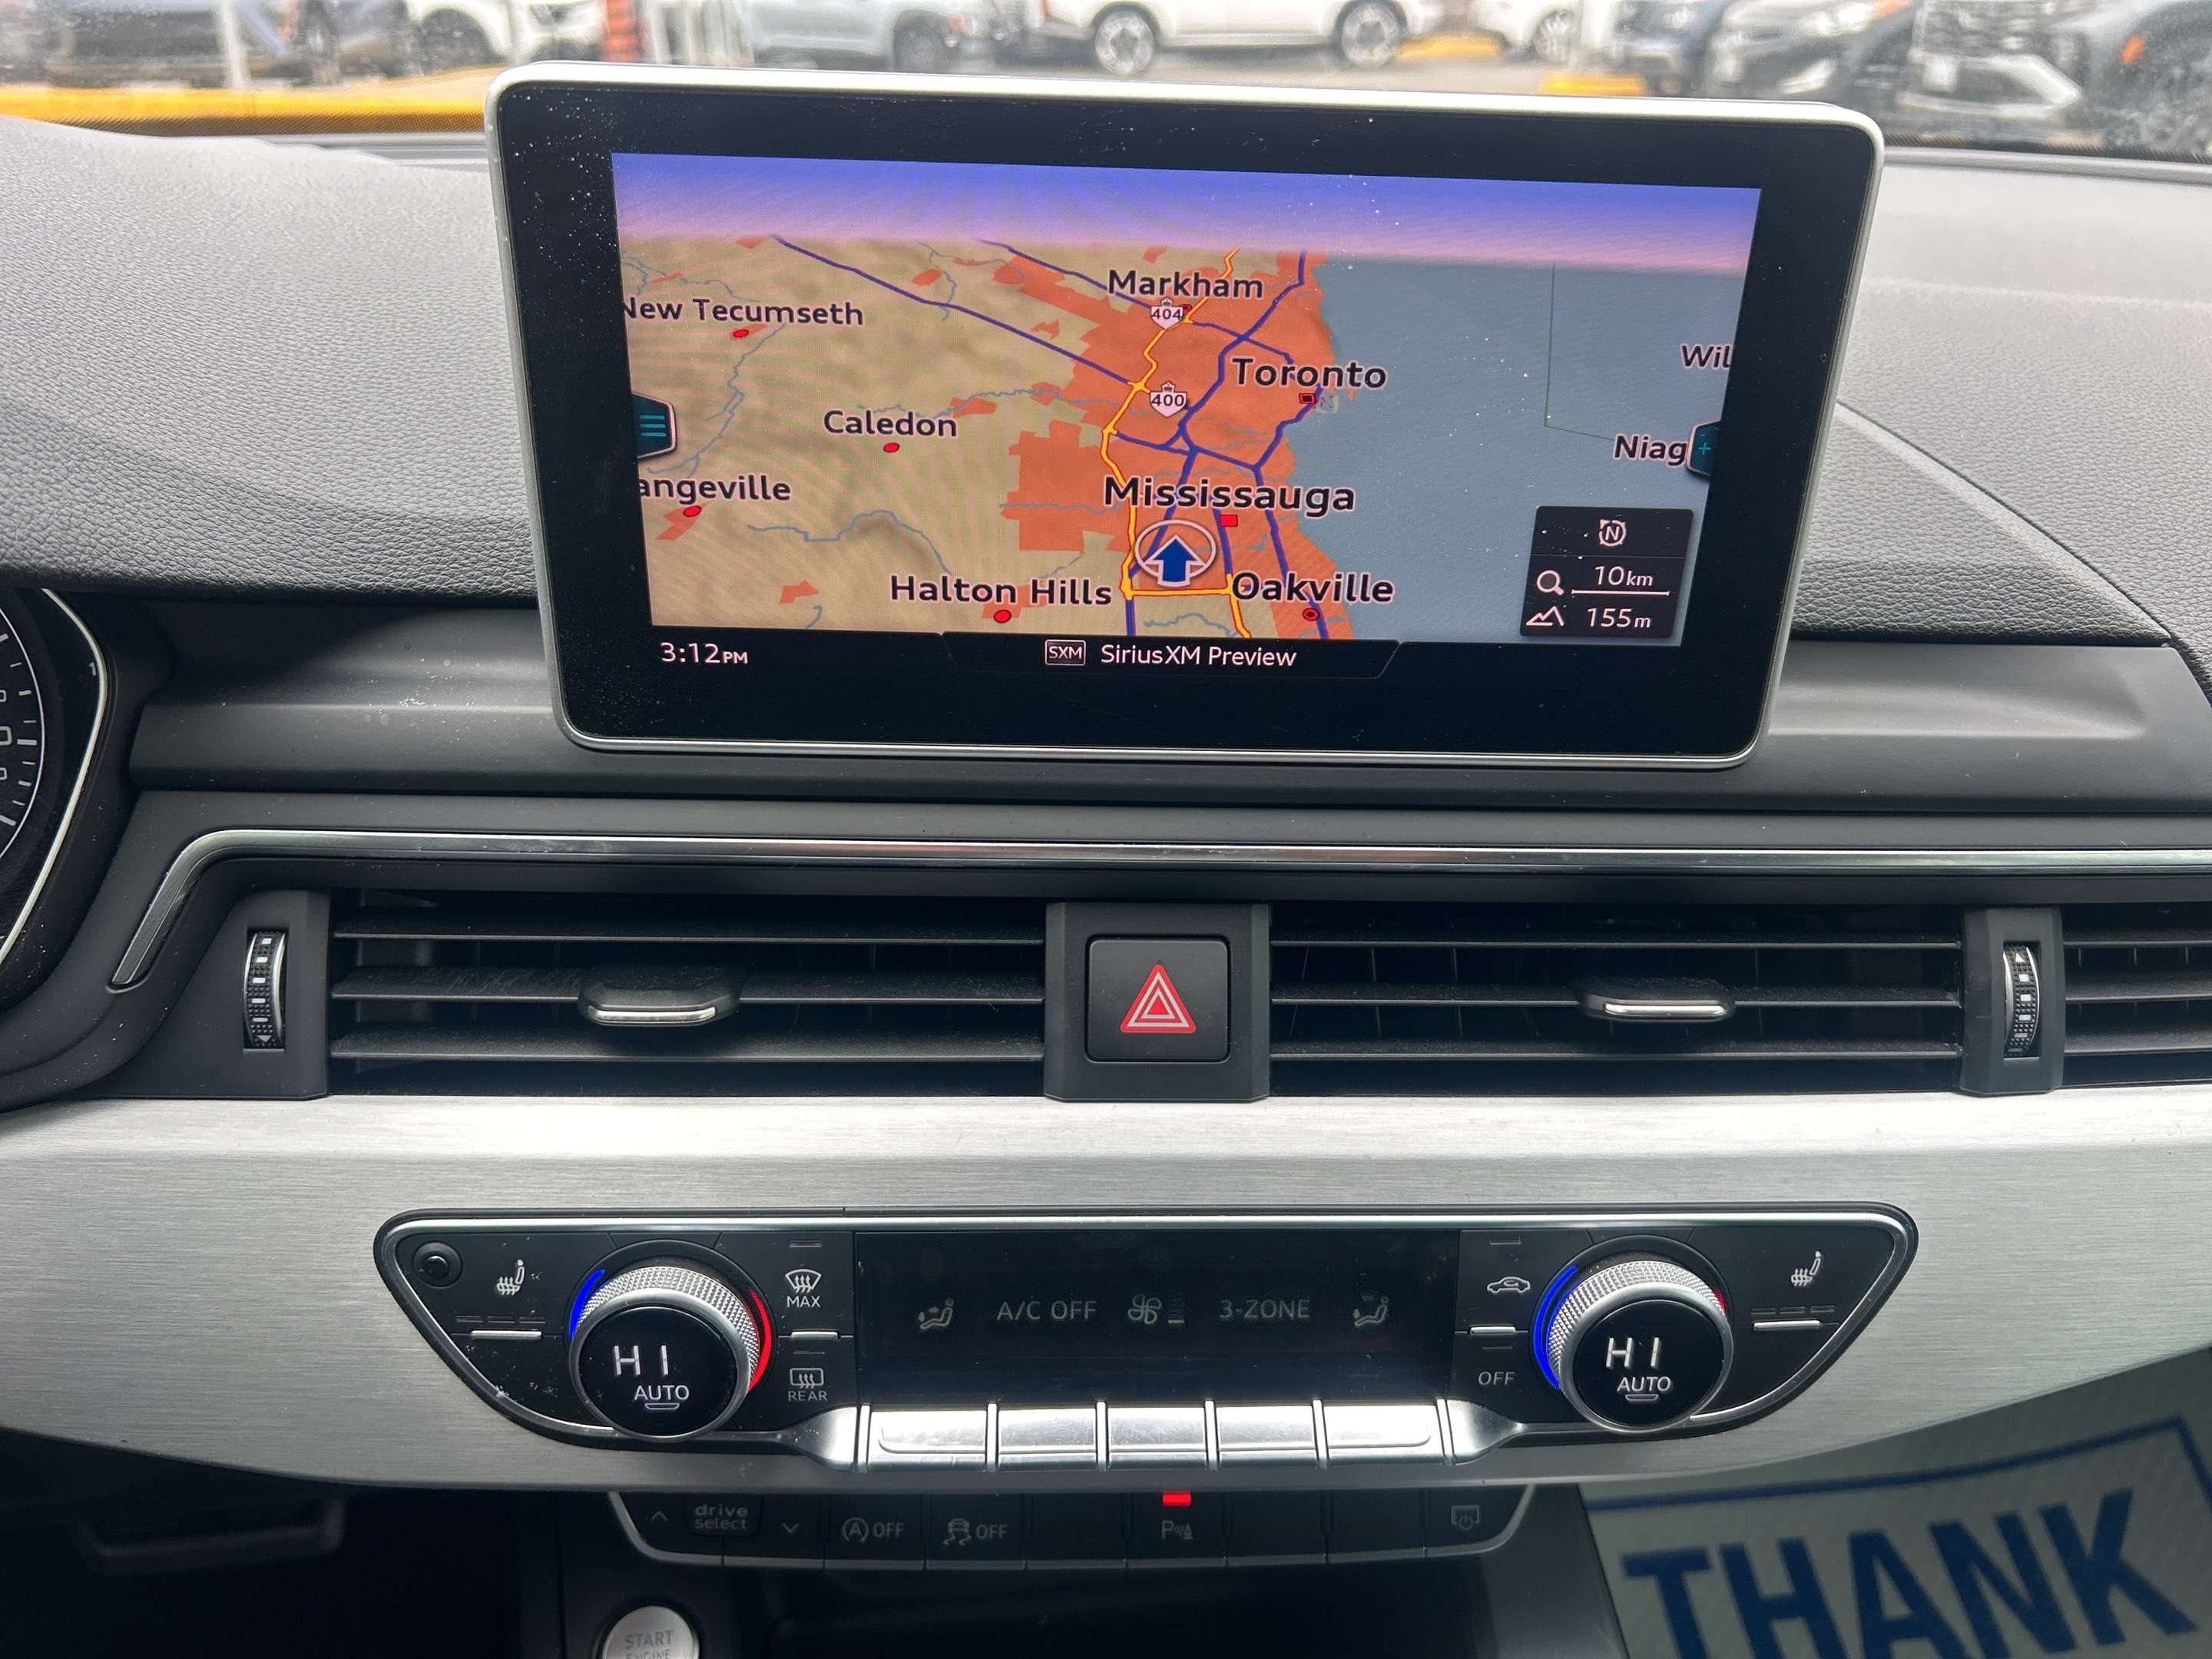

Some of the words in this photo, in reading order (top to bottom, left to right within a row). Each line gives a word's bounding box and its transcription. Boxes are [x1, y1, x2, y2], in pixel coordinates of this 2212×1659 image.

[1108, 270, 1263, 298] Markham
[623, 296, 683, 320] New
[692, 298, 863, 326] Tecumseth
[1152, 308, 1181, 321] 404
[1681, 345, 1731, 368] Wil
[1233, 358, 1387, 388] Toronto
[1152, 393, 1185, 407] 400
[824, 409, 957, 436] Caledon
[1614, 435, 1687, 466] Niag
[1104, 477, 1355, 518] Mississauga
[890, 575, 1017, 603] Halton
[1031, 579, 1112, 605] Hills
[1232, 571, 1394, 603] Oakville
[1048, 647, 1083, 661] SXM
[1101, 644, 1201, 667] SiriusXM
[1208, 647, 1296, 667] Preview
[787, 1296, 821, 1308] MAX
[997, 1300, 1041, 1321] A/C
[1051, 1300, 1098, 1320] OFF
[1219, 1300, 1311, 1320] 3-ZONE
[1478, 1371, 1515, 1386] OFF
[1617, 1377, 1671, 1392] AUTO
[634, 1385, 690, 1402] AUTO
[787, 1391, 828, 1402] REAR
[694, 1504, 749, 1518] drive
[694, 1517, 748, 1531] select
[873, 1522, 904, 1538] OFF
[975, 1524, 1008, 1539] OFF
[1622, 1488, 2197, 1659] THANK
[625, 1629, 674, 1650] START
